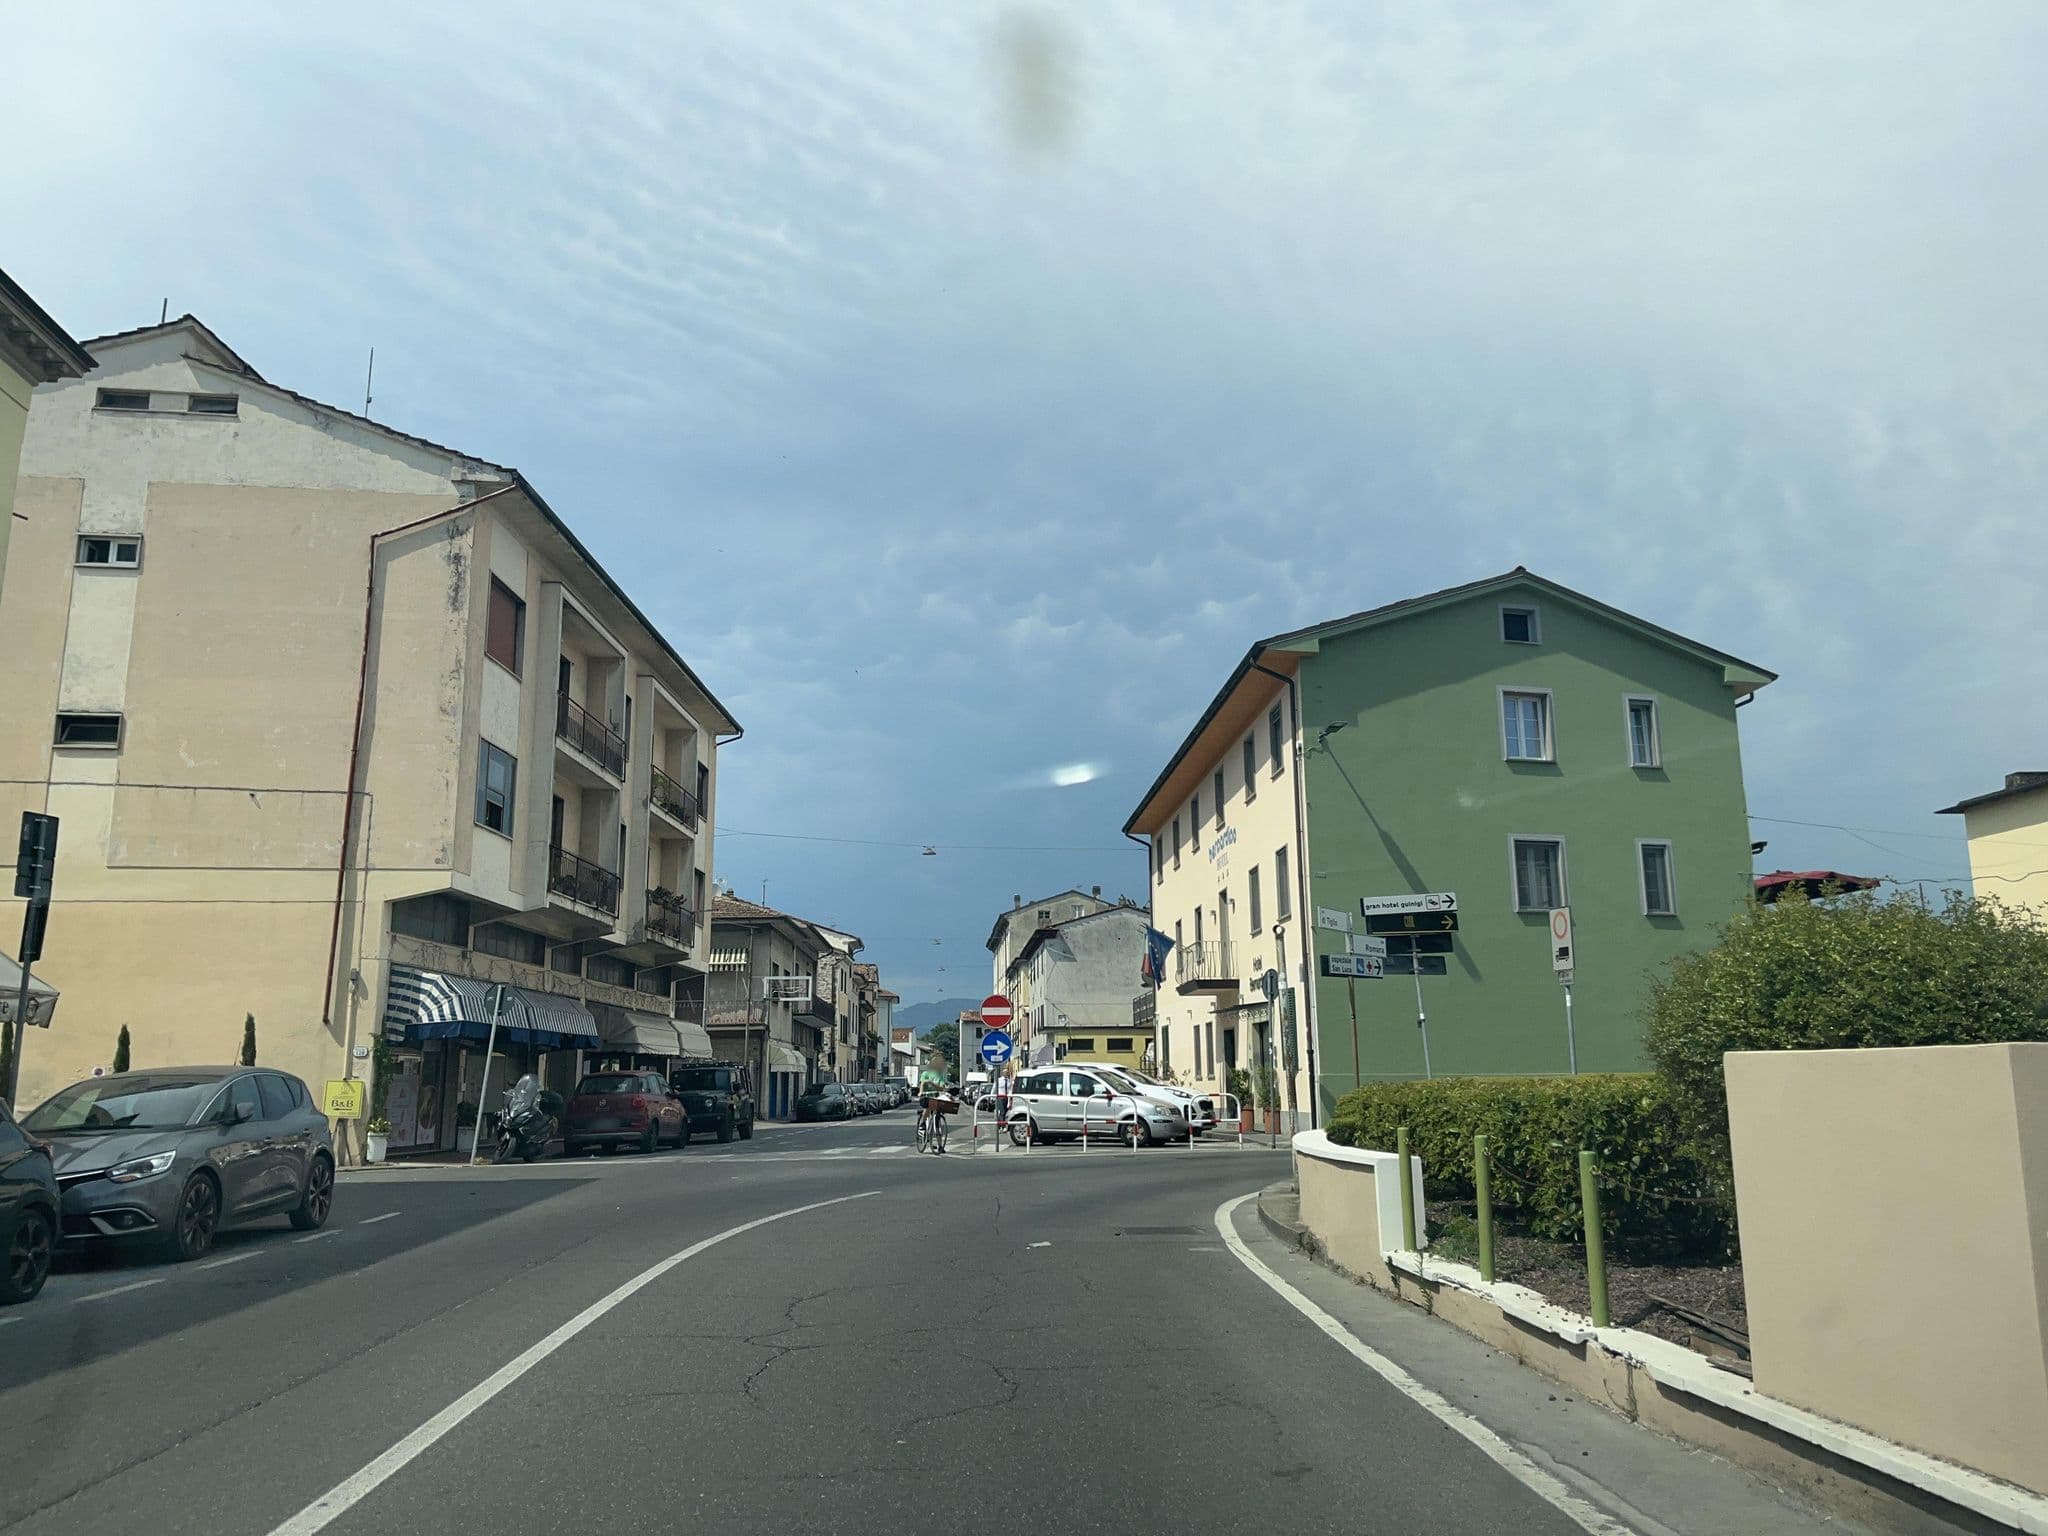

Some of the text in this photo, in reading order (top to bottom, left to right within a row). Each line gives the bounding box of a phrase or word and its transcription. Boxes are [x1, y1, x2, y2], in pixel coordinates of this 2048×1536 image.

[1332, 964, 1352, 973] San Luca
[331, 1099, 354, 1108] B&B
